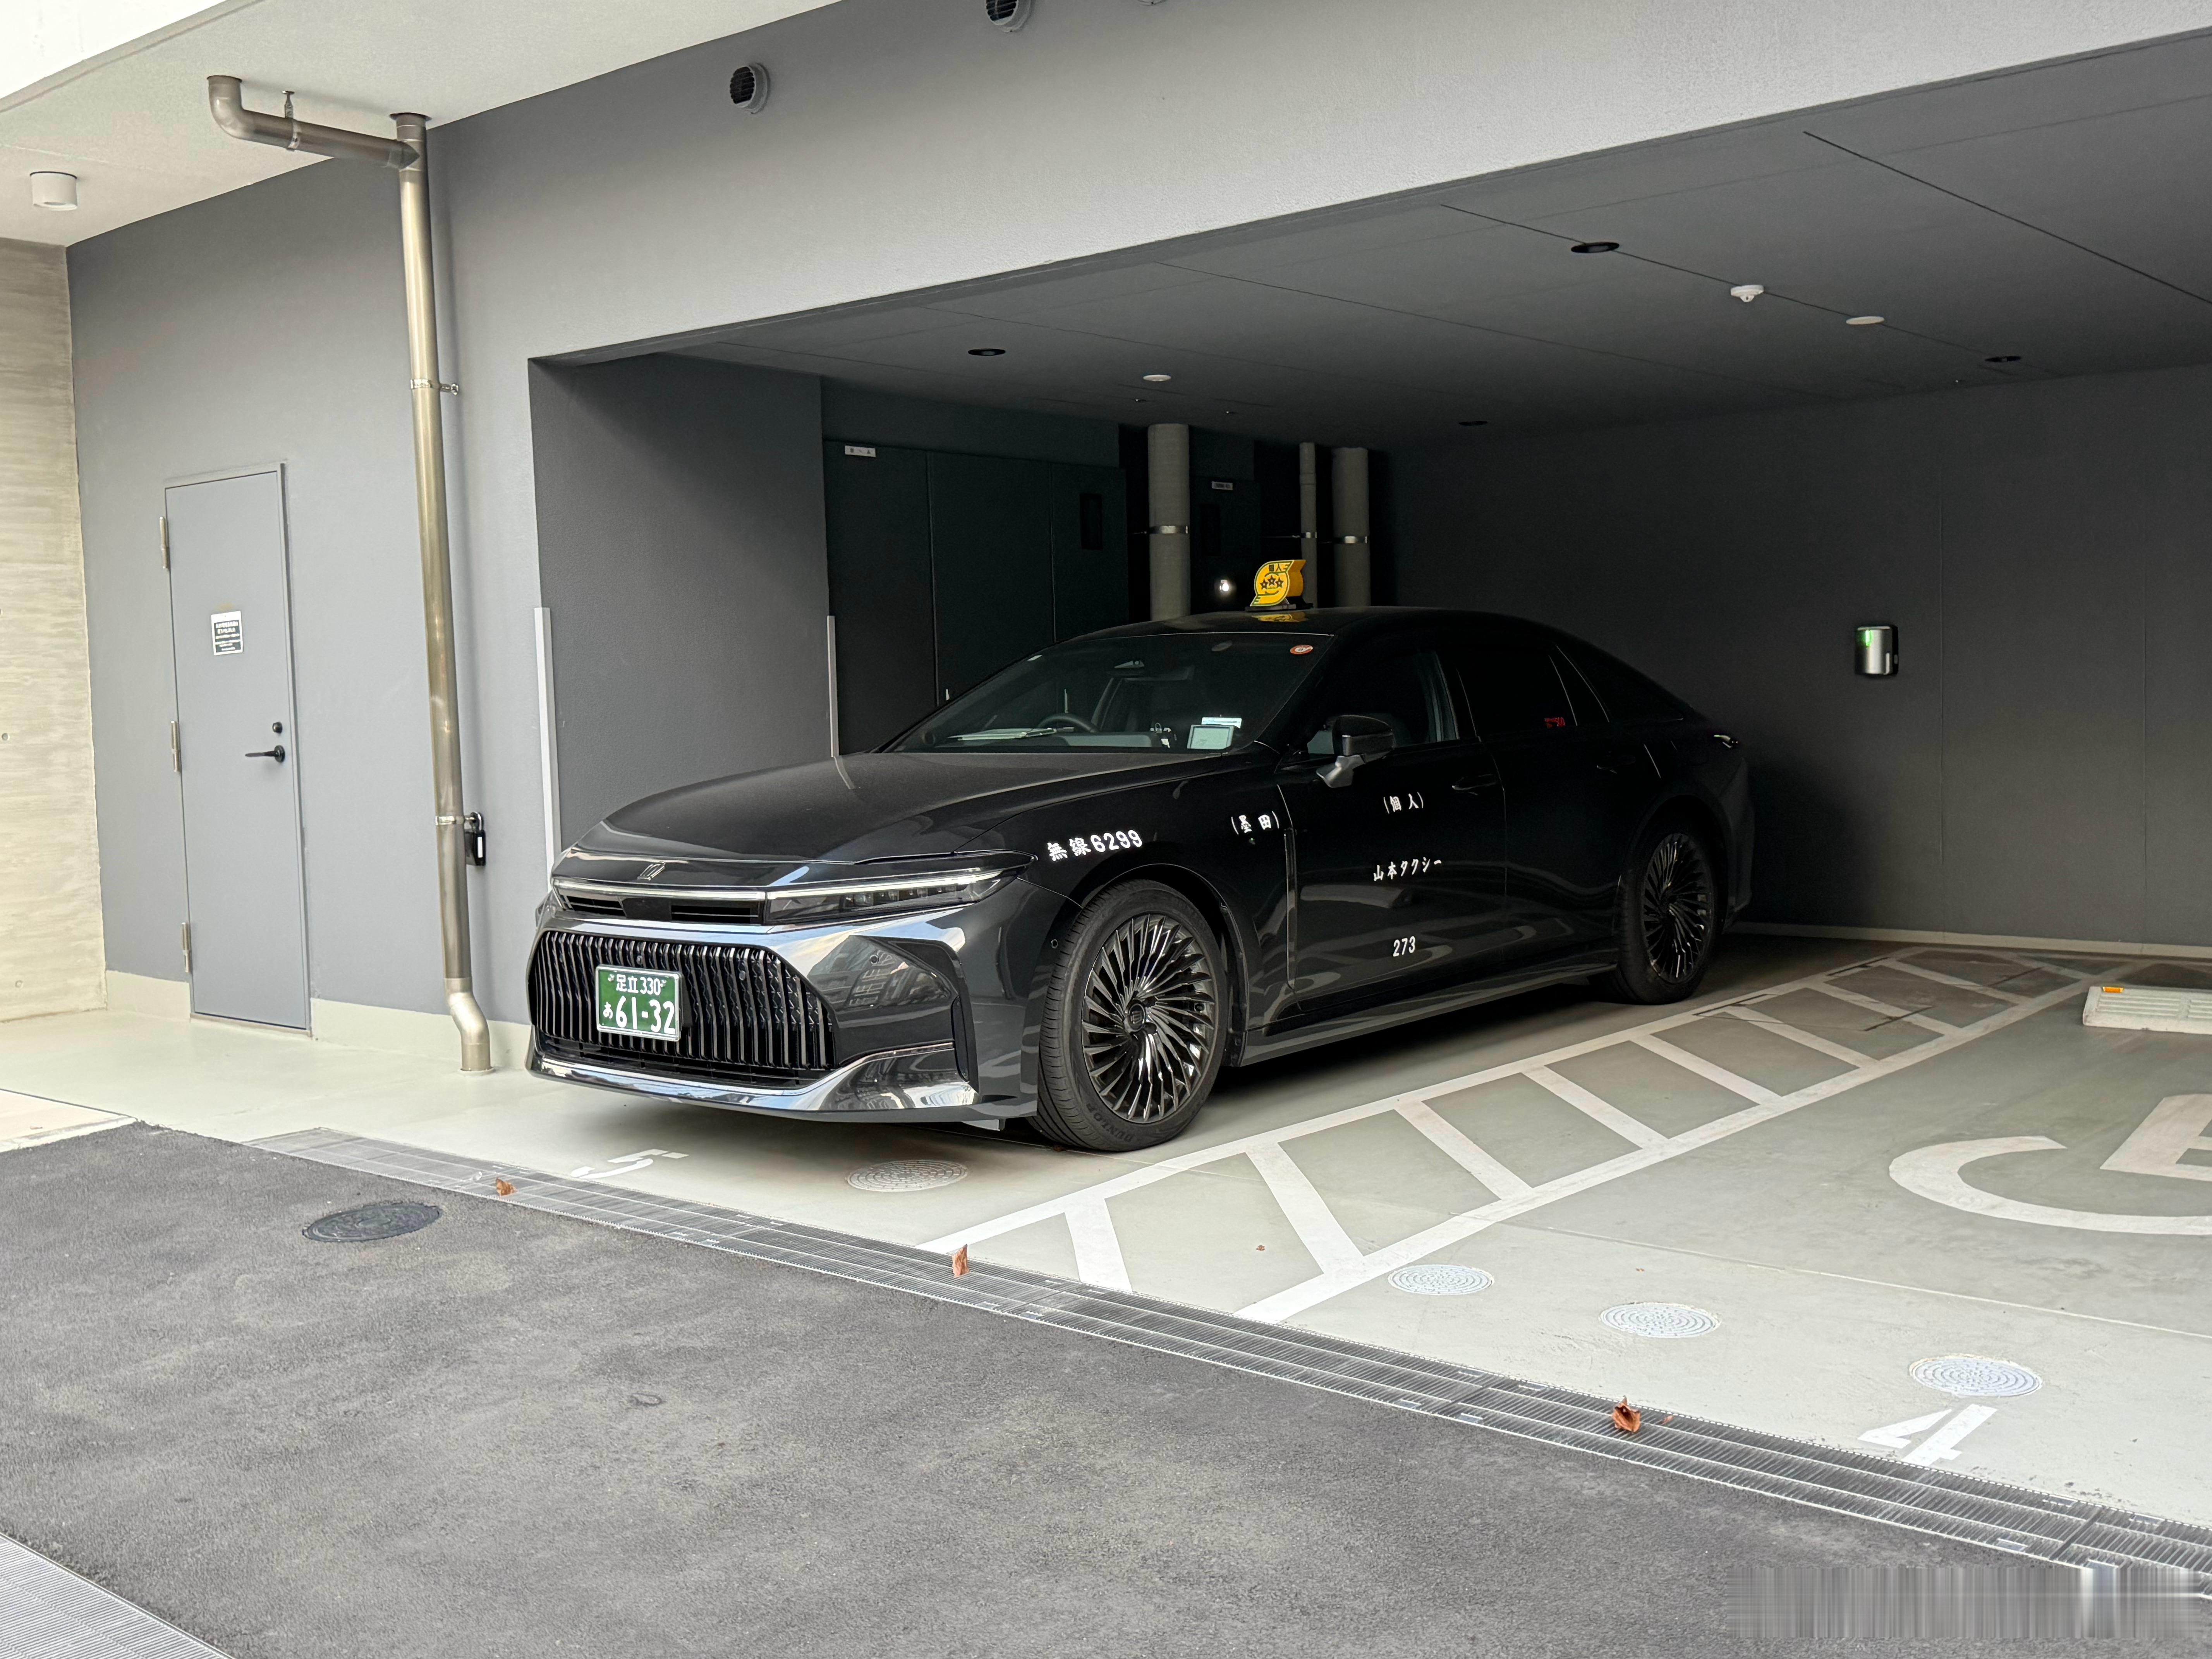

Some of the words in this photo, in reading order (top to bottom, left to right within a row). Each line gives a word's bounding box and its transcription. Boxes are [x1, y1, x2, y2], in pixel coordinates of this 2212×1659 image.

[1373, 857, 1442, 881] 山本タクシー
[1393, 936, 1415, 957] 273
[640, 976, 661, 996] 330
[616, 995, 676, 1035] 61-32
[570, 1149, 689, 1179] 5
[1857, 1403, 1997, 1466] 4
